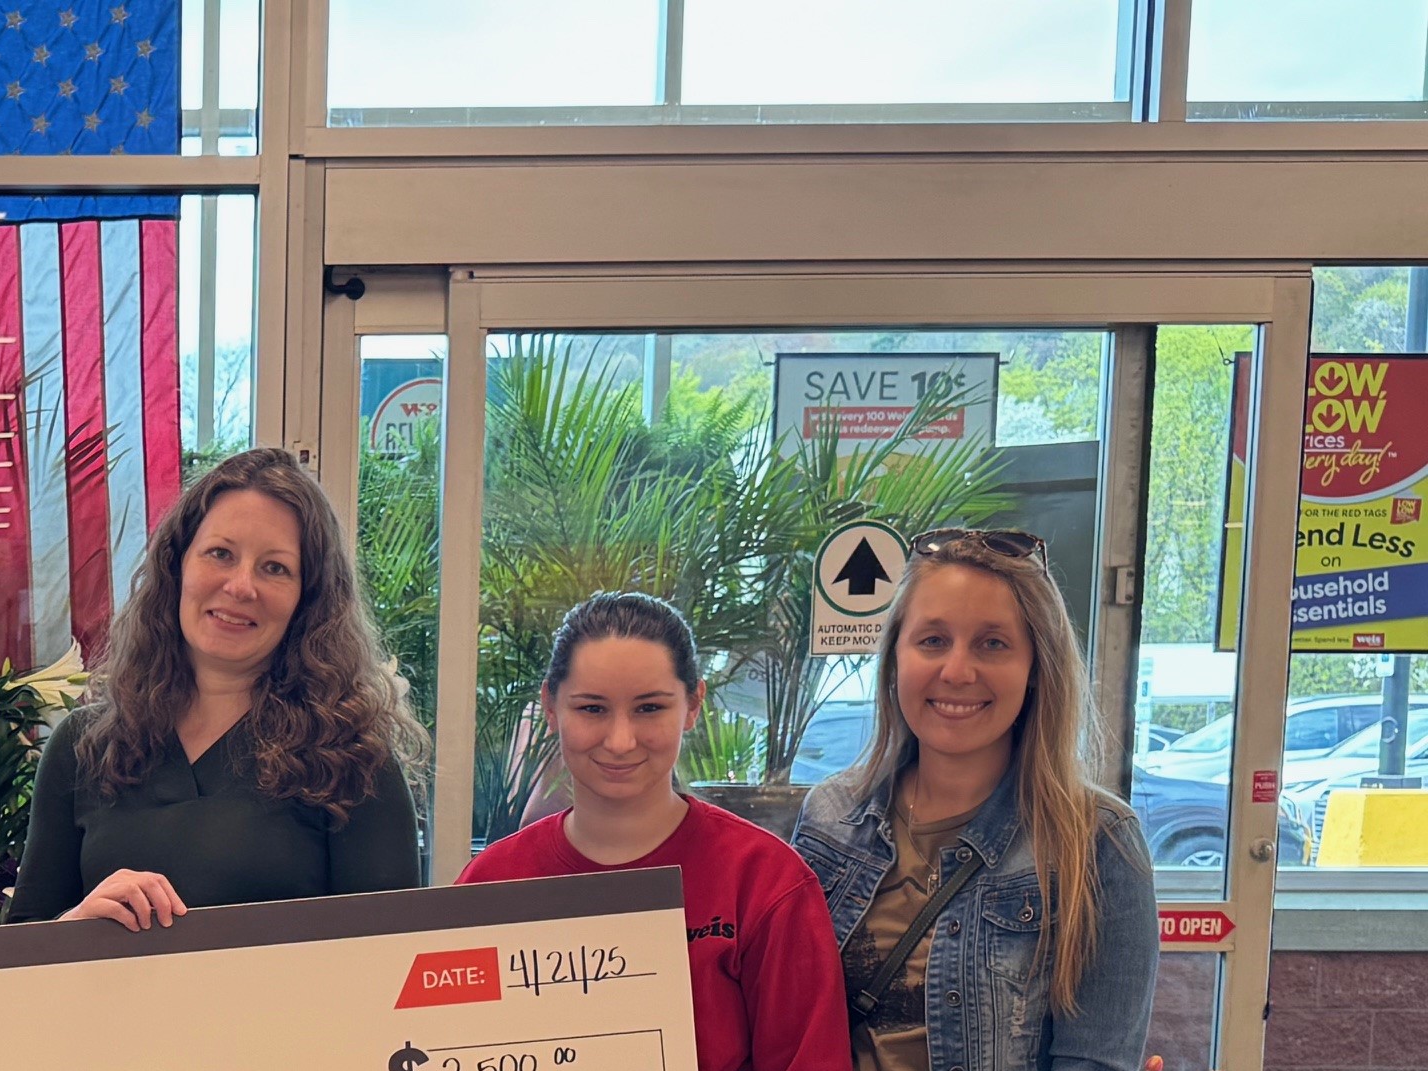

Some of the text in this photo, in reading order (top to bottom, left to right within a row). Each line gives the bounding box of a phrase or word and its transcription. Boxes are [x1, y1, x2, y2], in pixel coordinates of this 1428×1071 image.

[804, 371, 899, 400] SAVE
[1307, 361, 1390, 399] OW,
[866, 411, 883, 420] 100
[1305, 399, 1387, 433] OW
[1340, 439, 1393, 485] day!
[1299, 509, 1319, 518] OR
[1322, 509, 1339, 518] THE
[1342, 509, 1361, 517] RED
[1364, 509, 1387, 518] TAGS
[1352, 523, 1416, 558] Less
[1320, 555, 1341, 568] on
[818, 624, 872, 633] AUTOMATIC
[821, 636, 851, 645] KEEP
[1158, 917, 1222, 936] TO OPEN
[422, 945, 627, 996] DATE: 4/21/25
